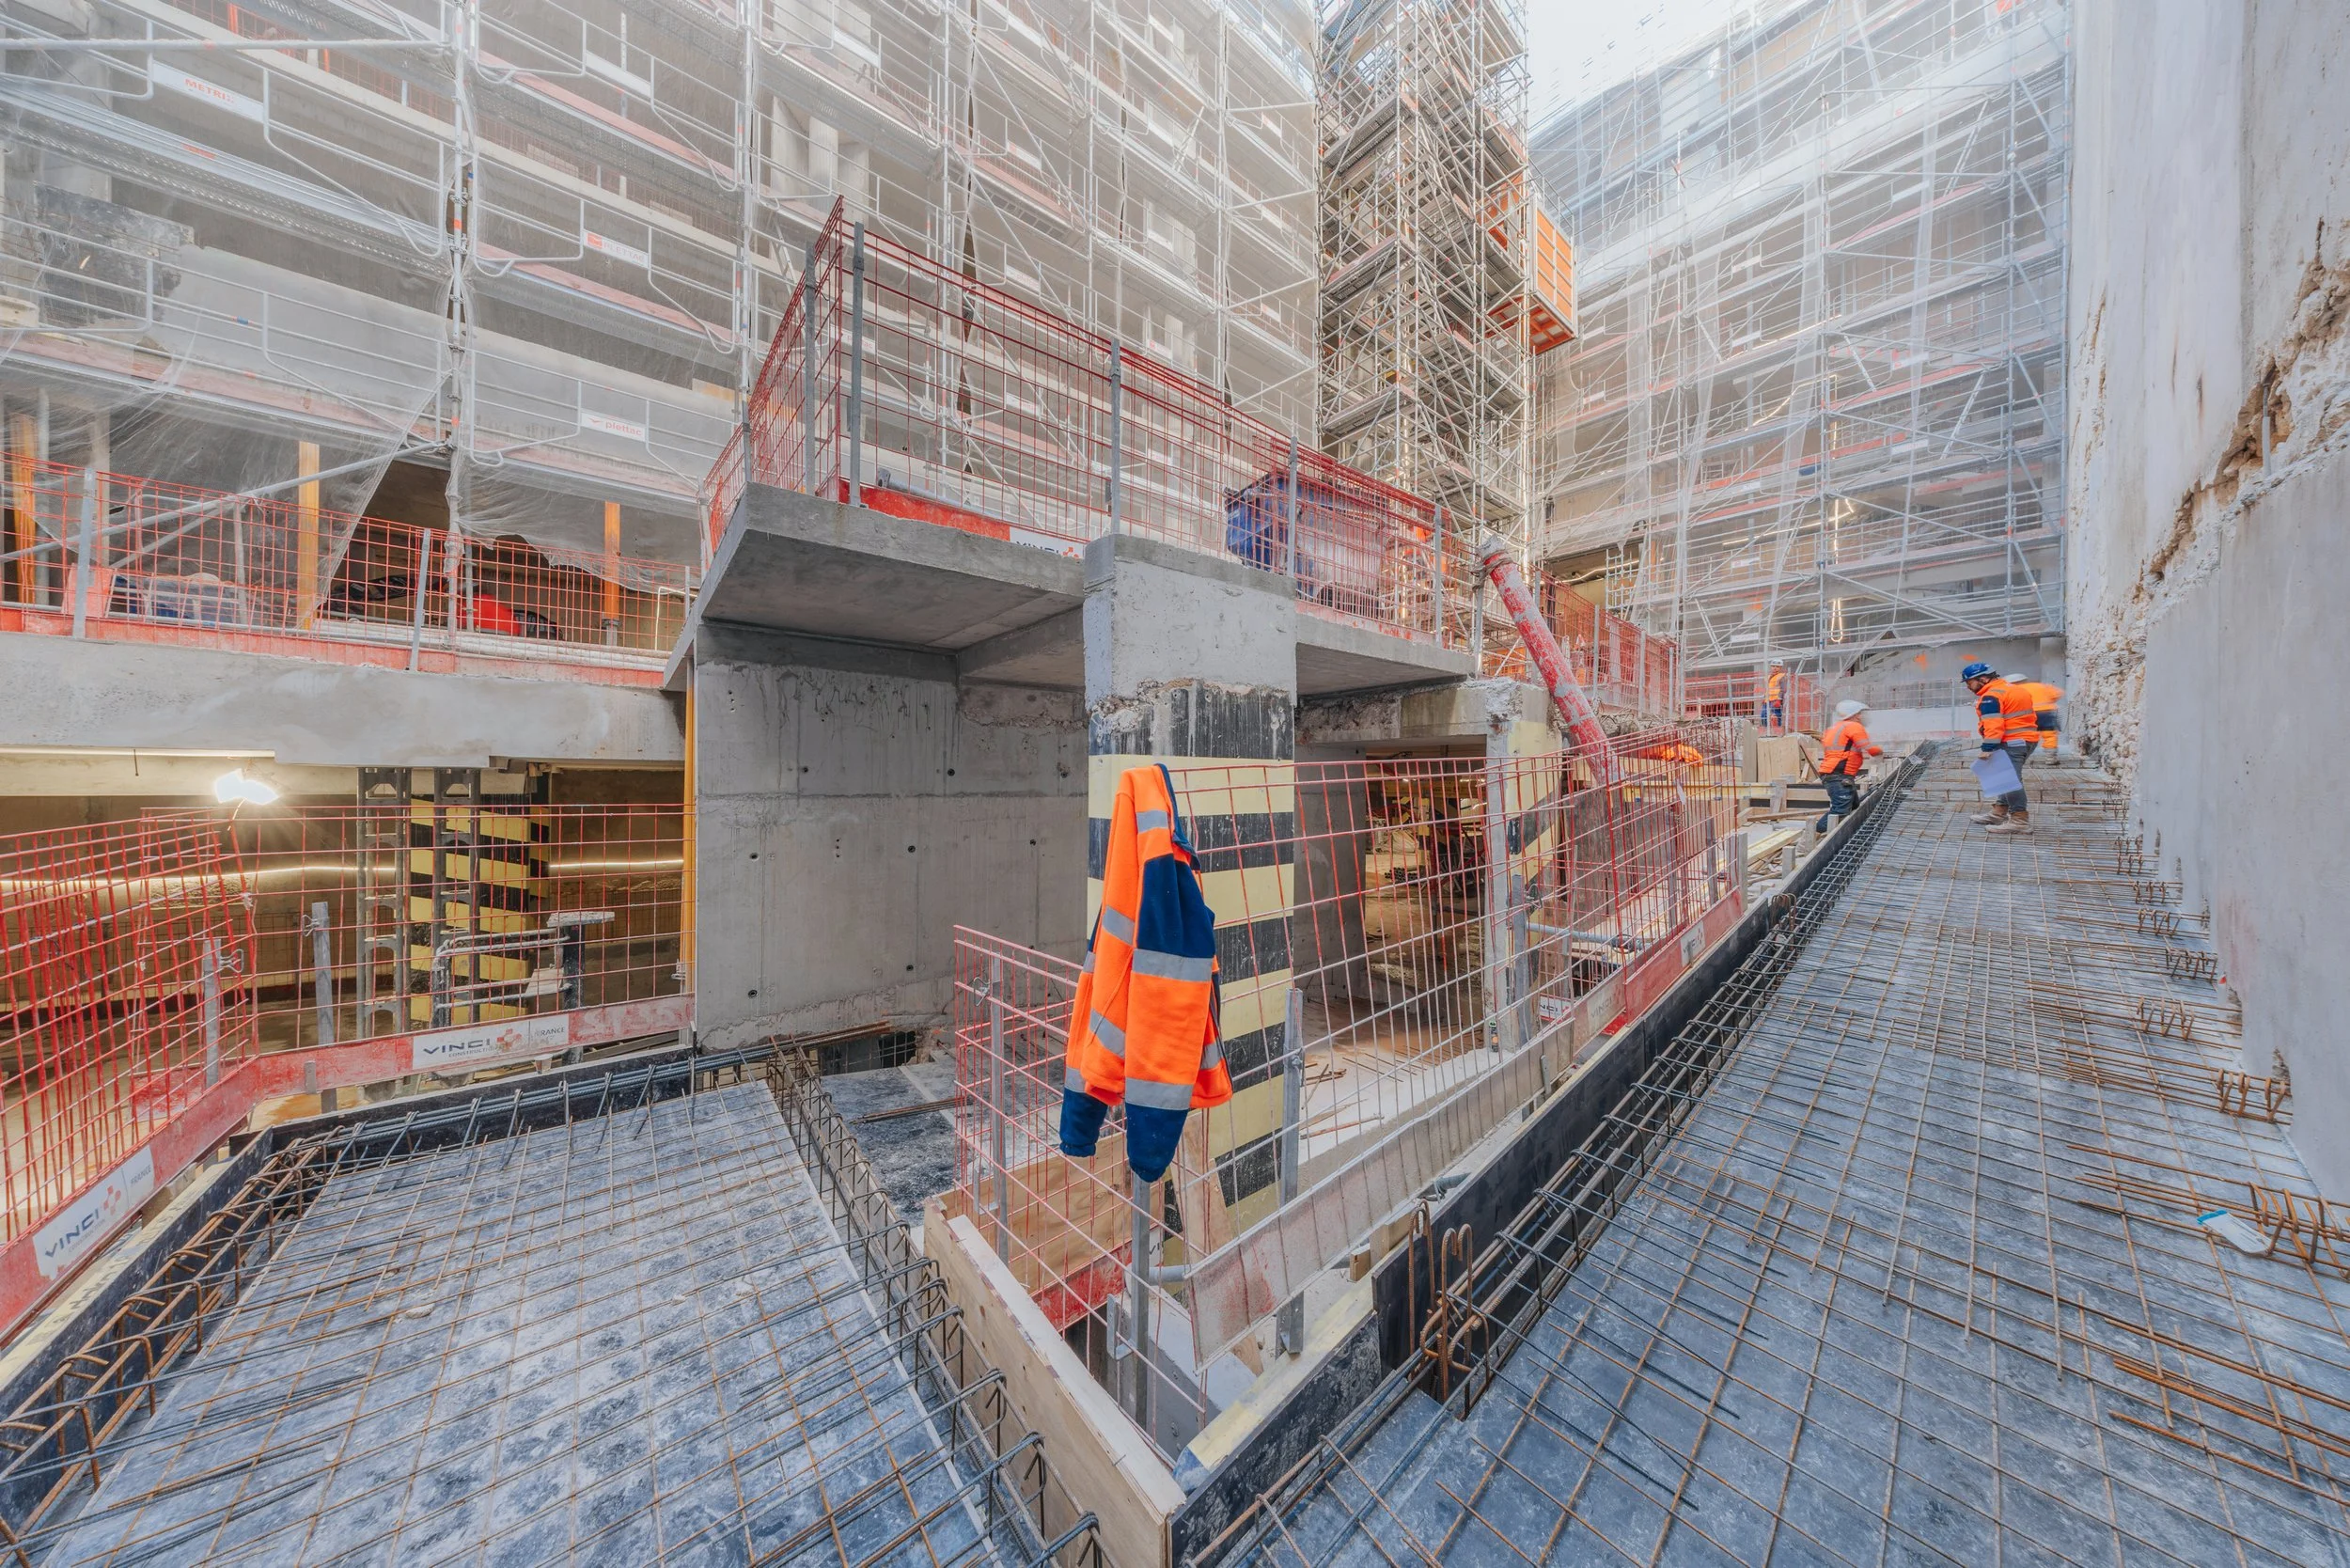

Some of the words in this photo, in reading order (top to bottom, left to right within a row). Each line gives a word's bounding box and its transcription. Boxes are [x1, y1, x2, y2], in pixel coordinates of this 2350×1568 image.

[423, 1038, 491, 1055] VINCI
[537, 1027, 565, 1037] RANCE
[44, 1208, 100, 1258] VINCI
